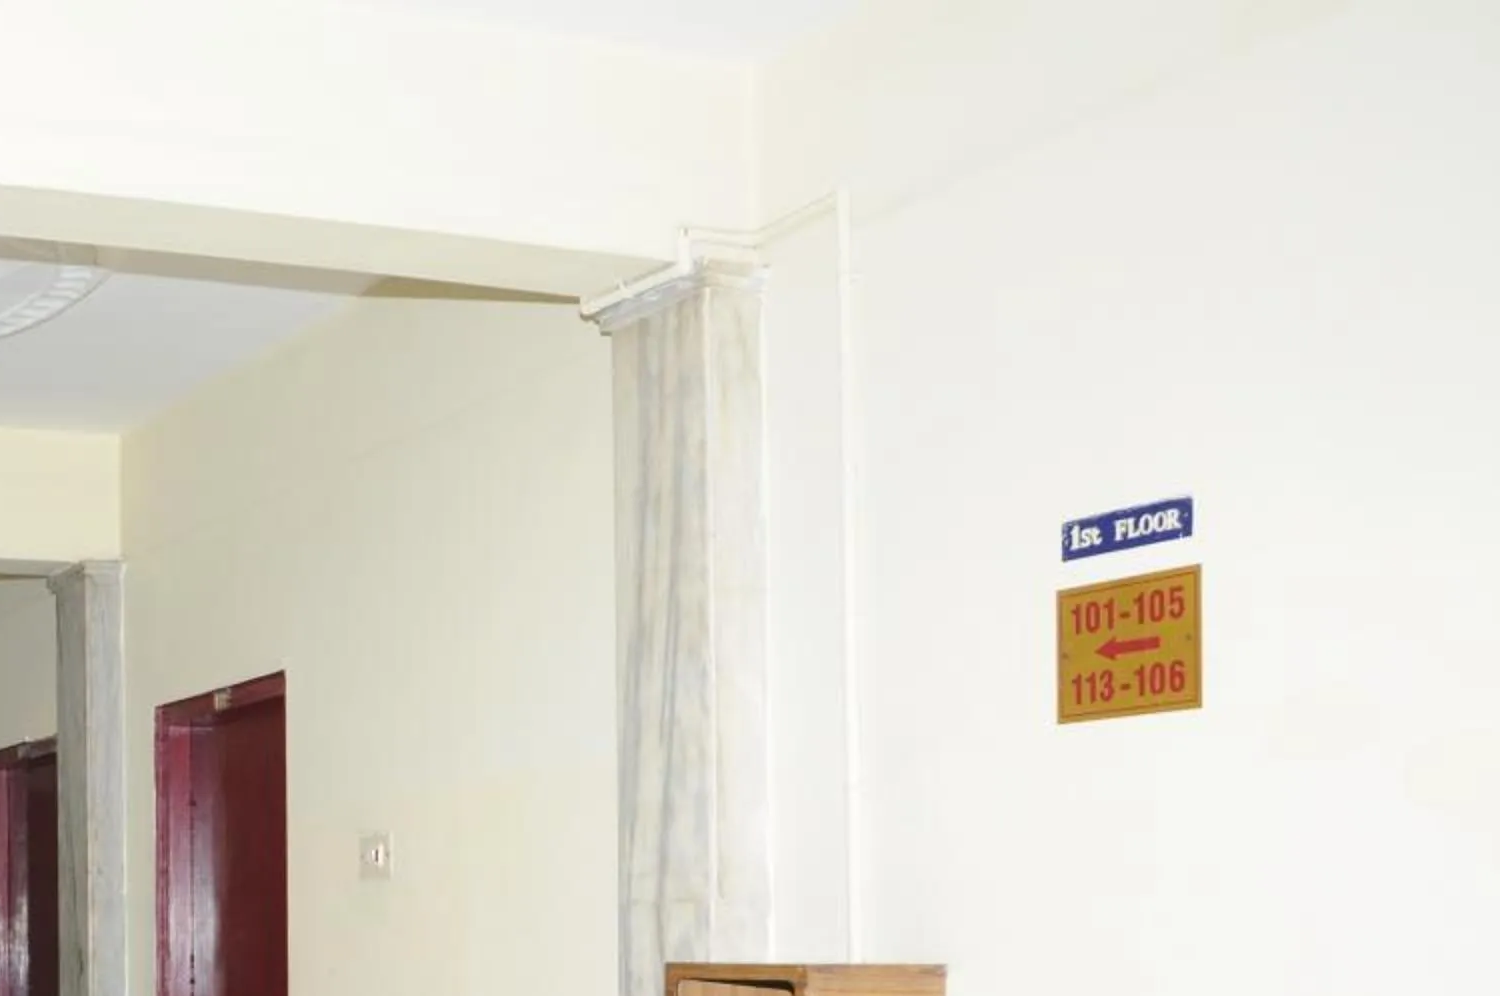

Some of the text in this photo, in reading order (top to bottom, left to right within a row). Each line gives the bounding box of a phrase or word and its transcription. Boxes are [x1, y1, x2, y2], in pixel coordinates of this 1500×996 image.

[1069, 508, 1182, 550] 1st FLOOR
[1071, 586, 1185, 635] 101-105
[1071, 660, 1185, 705] 113-106
